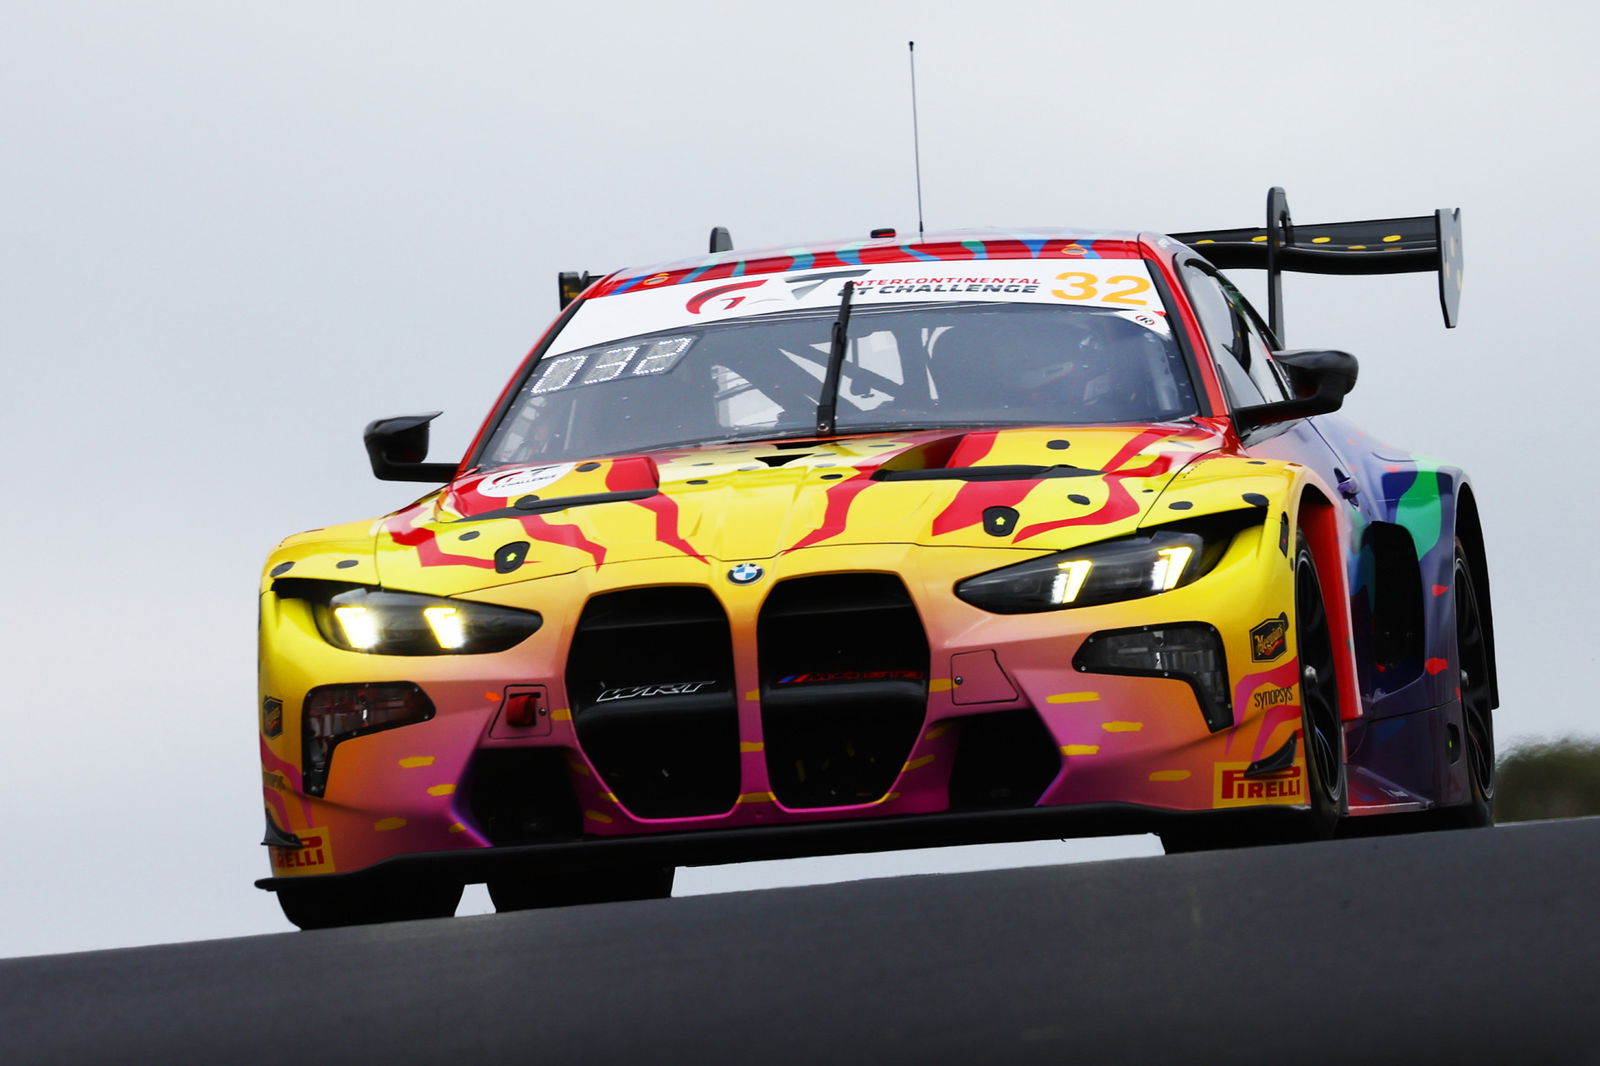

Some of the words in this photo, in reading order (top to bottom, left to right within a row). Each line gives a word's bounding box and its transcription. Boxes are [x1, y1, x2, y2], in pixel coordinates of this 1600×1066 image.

[846, 277, 1042, 288] NTERCONTINENTAL
[878, 284, 1039, 295] CHALLENGE
[1051, 271, 1151, 306] 32
[531, 337, 693, 394] 032
[596, 680, 716, 702] WRT
[1221, 766, 1302, 799] PIRELLI
